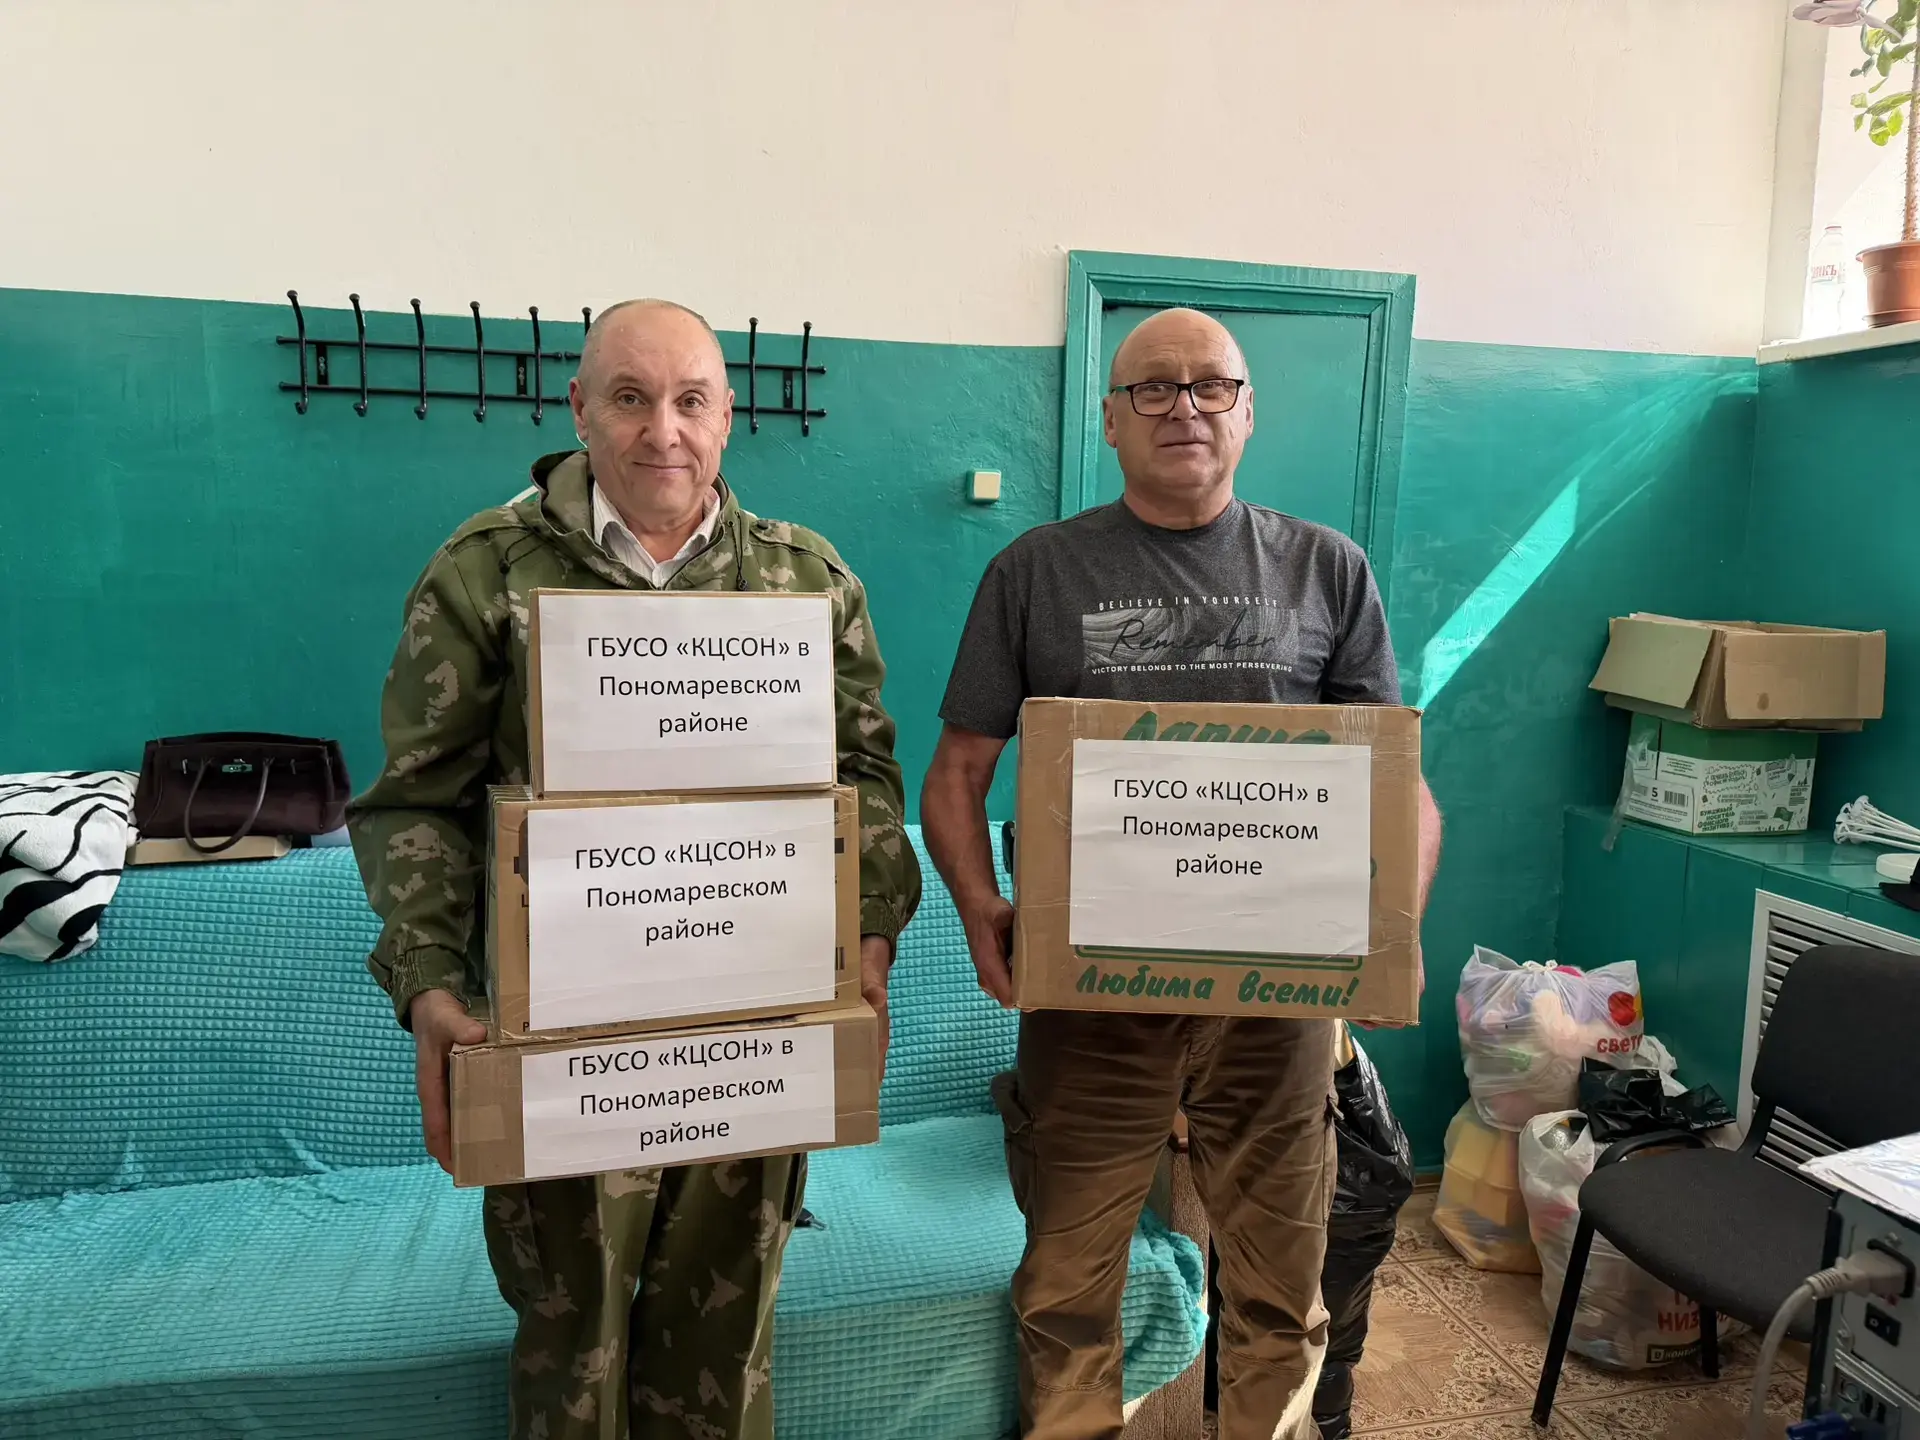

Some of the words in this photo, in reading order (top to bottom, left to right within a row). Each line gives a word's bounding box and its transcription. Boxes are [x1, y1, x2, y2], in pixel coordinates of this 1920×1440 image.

[1099, 598, 1163, 611] BELIEVE
[1175, 597, 1190, 605] IN
[1202, 596, 1278, 608] YOURSELF
[1109, 607, 1275, 657] Remember
[588, 637, 668, 657] ГБУСО
[676, 637, 790, 662] «КЦСОН»
[798, 642, 810, 657] в
[1092, 664, 1128, 675] VICTORY
[1130, 664, 1172, 673] BELONGS
[1190, 663, 1206, 671] THE
[1209, 662, 1233, 670] MOST
[1236, 662, 1293, 673] PERSEVERING
[599, 676, 801, 700] Пономаревском
[659, 711, 748, 738] районе
[1114, 779, 1188, 800] ГБУСО
[1196, 781, 1309, 806] «КЦСОН»
[1317, 788, 1329, 803] в
[1651, 787, 1658, 798] 5
[1123, 815, 1318, 842] Пономаревском
[576, 845, 656, 870] ГБУСО
[664, 840, 776, 867] «КЦСОН»
[784, 842, 796, 858] в
[1176, 853, 1263, 878] районе
[587, 880, 787, 908] Пономаревском
[646, 918, 734, 947] районе
[1076, 965, 1215, 999] Любима
[1237, 970, 1359, 1007] всеми!
[569, 1050, 649, 1077] ГБУСО
[657, 1038, 773, 1068] «КЦСОН»
[782, 1039, 794, 1055] в
[580, 1078, 785, 1116] Пономаревском
[640, 1121, 730, 1152] районе
[1658, 1311, 1699, 1332] НИЗ
